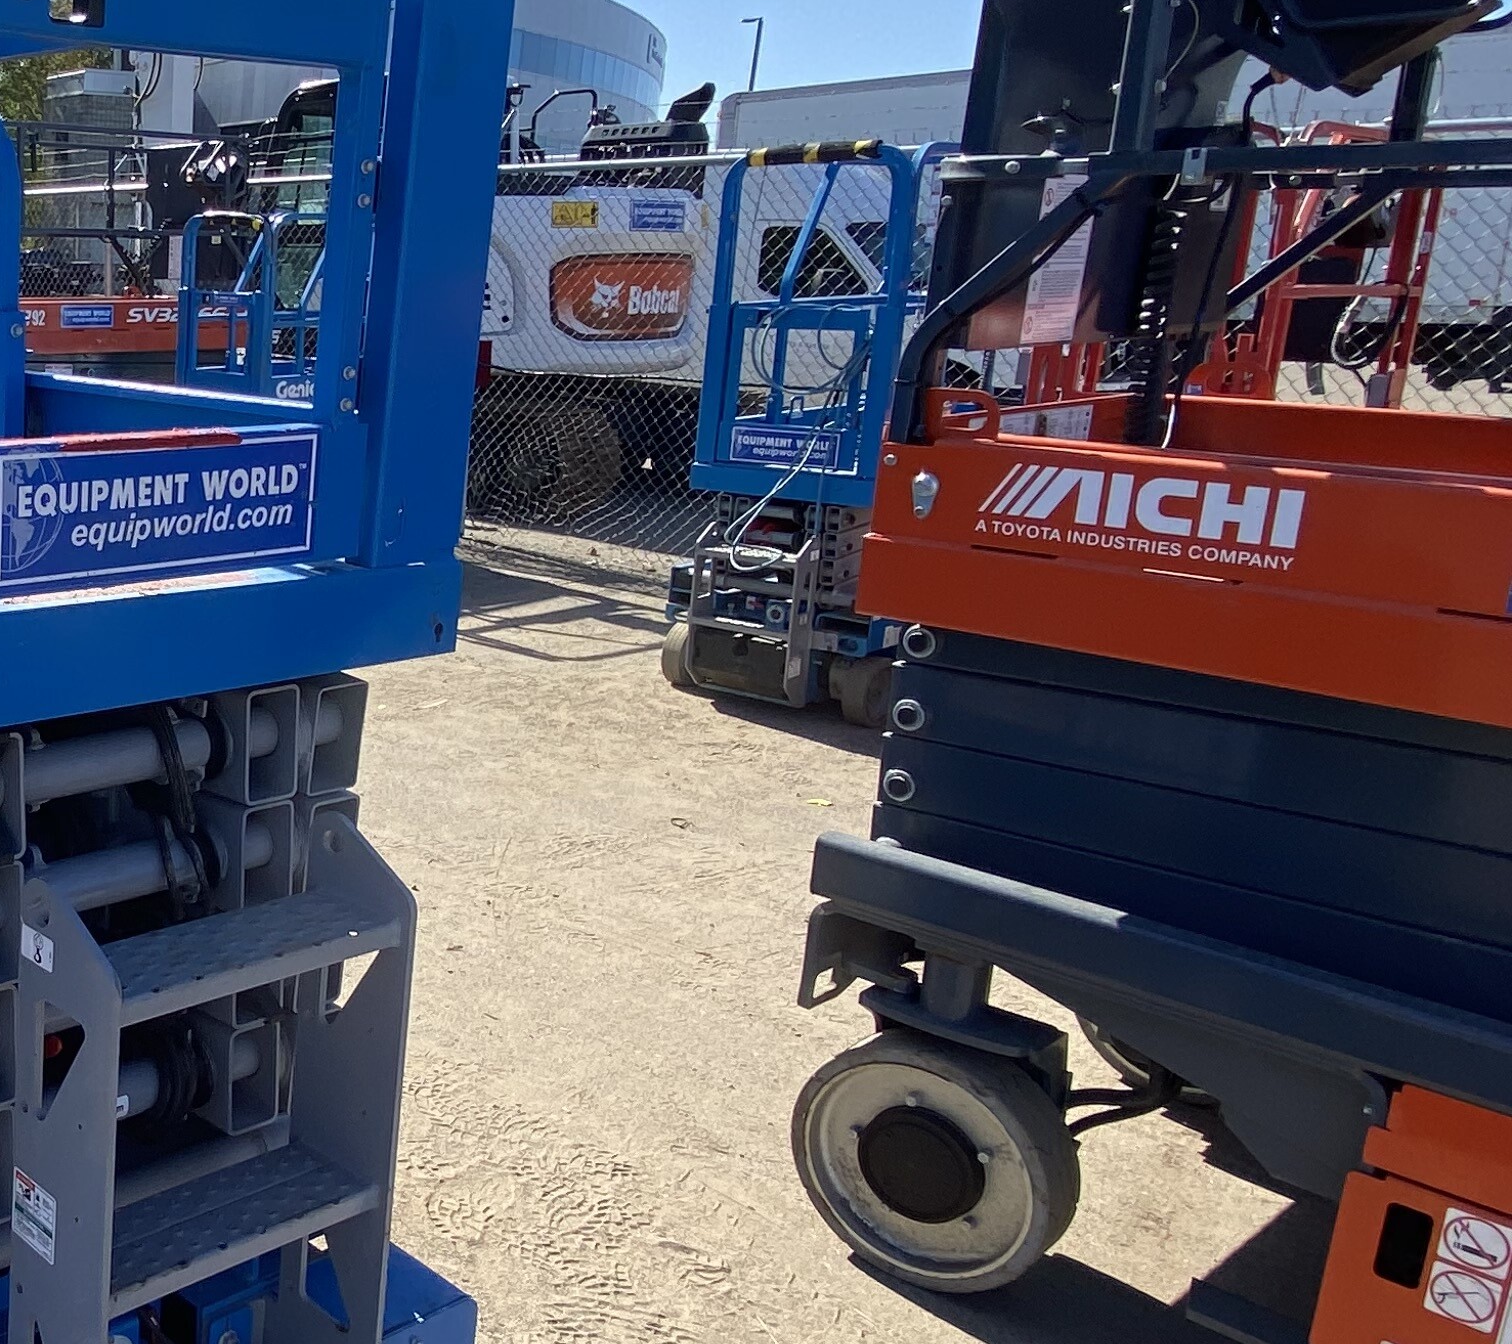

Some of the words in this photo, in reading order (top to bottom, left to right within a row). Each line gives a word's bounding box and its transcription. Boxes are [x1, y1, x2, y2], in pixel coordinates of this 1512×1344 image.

[17, 473, 189, 518] EQUIPMENT
[202, 464, 299, 501] WORLD
[978, 463, 1305, 549] AICHI
[71, 502, 292, 551] equipworld.com
[974, 519, 987, 533] A
[991, 520, 1061, 542] TOYOTA
[1067, 530, 1182, 557] INDUSTRIES
[1188, 545, 1294, 571] COMPANY
